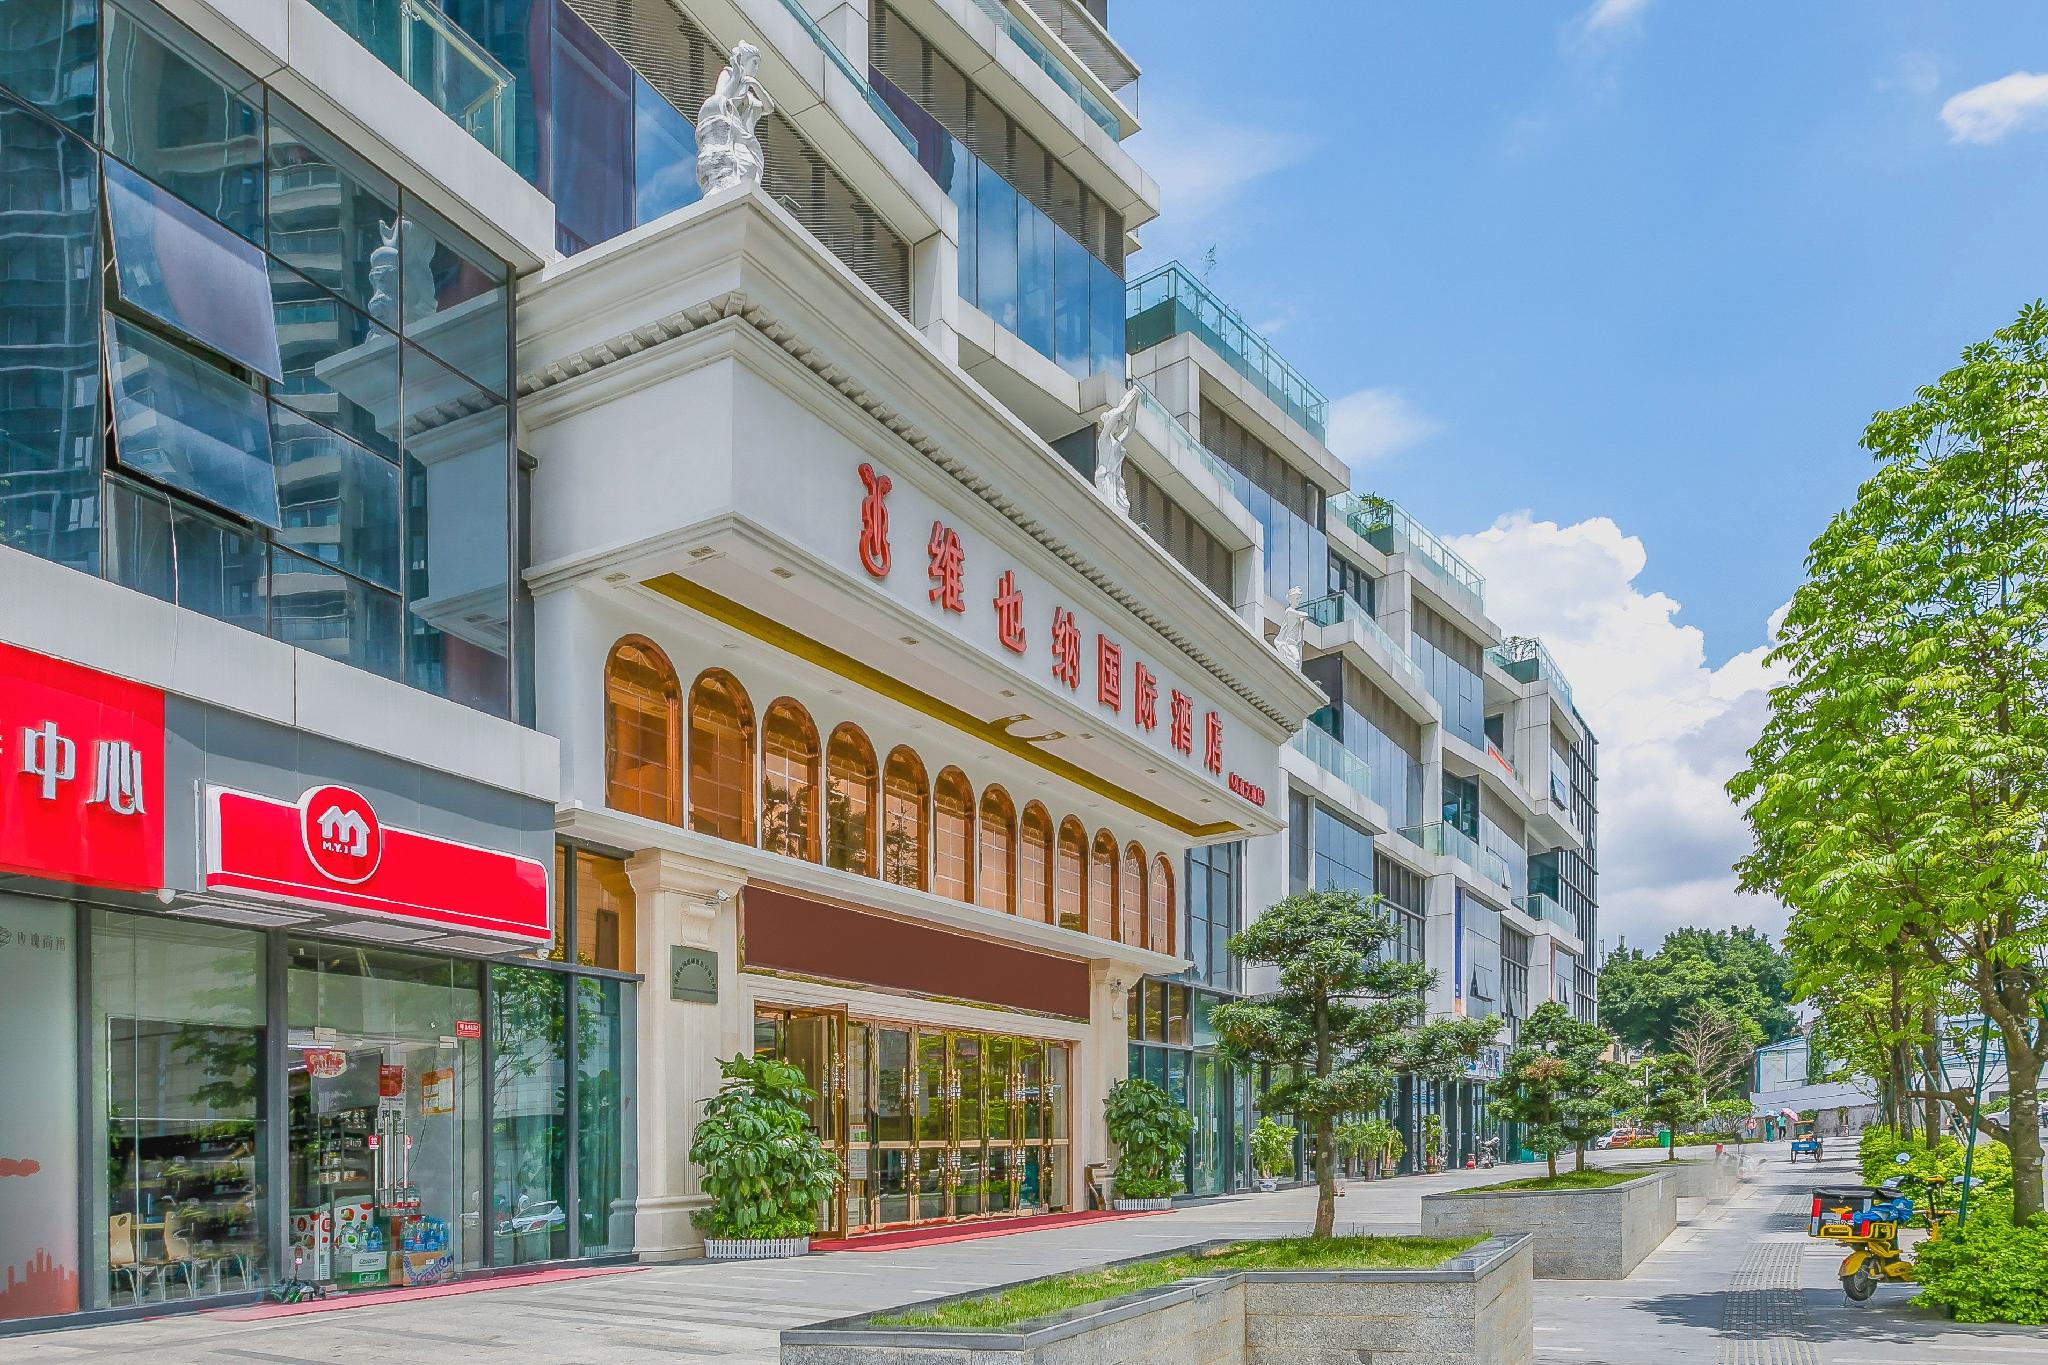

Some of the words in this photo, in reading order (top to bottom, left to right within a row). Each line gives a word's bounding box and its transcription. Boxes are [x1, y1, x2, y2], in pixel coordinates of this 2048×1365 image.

[928, 520, 1224, 776] 维也纳国际酒店
[0, 720, 147, 815] 中心
